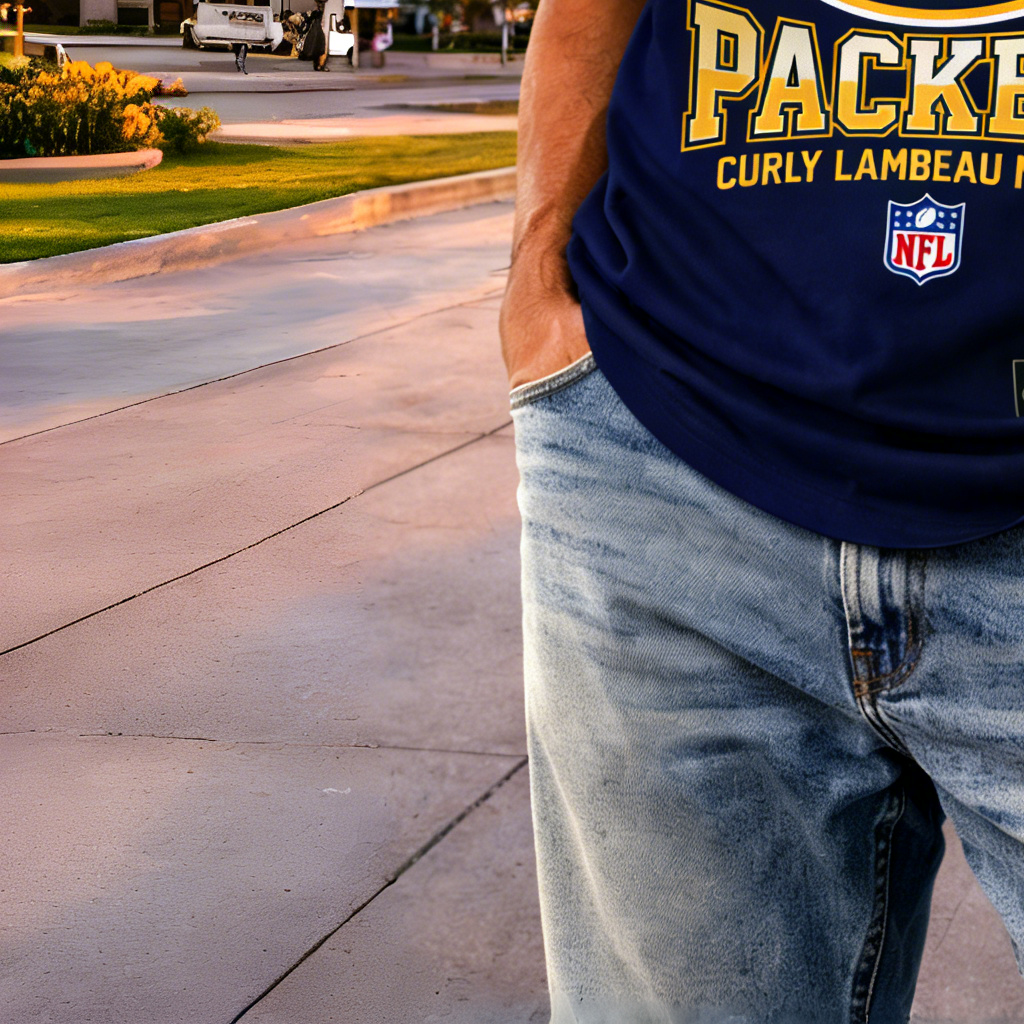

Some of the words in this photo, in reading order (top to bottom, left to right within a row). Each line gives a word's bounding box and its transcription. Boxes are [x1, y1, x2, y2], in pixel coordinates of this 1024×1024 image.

[716, 150, 823, 190] CURLY
[834, 147, 1003, 186] LAMBEAU
[894, 233, 954, 271] NFL
